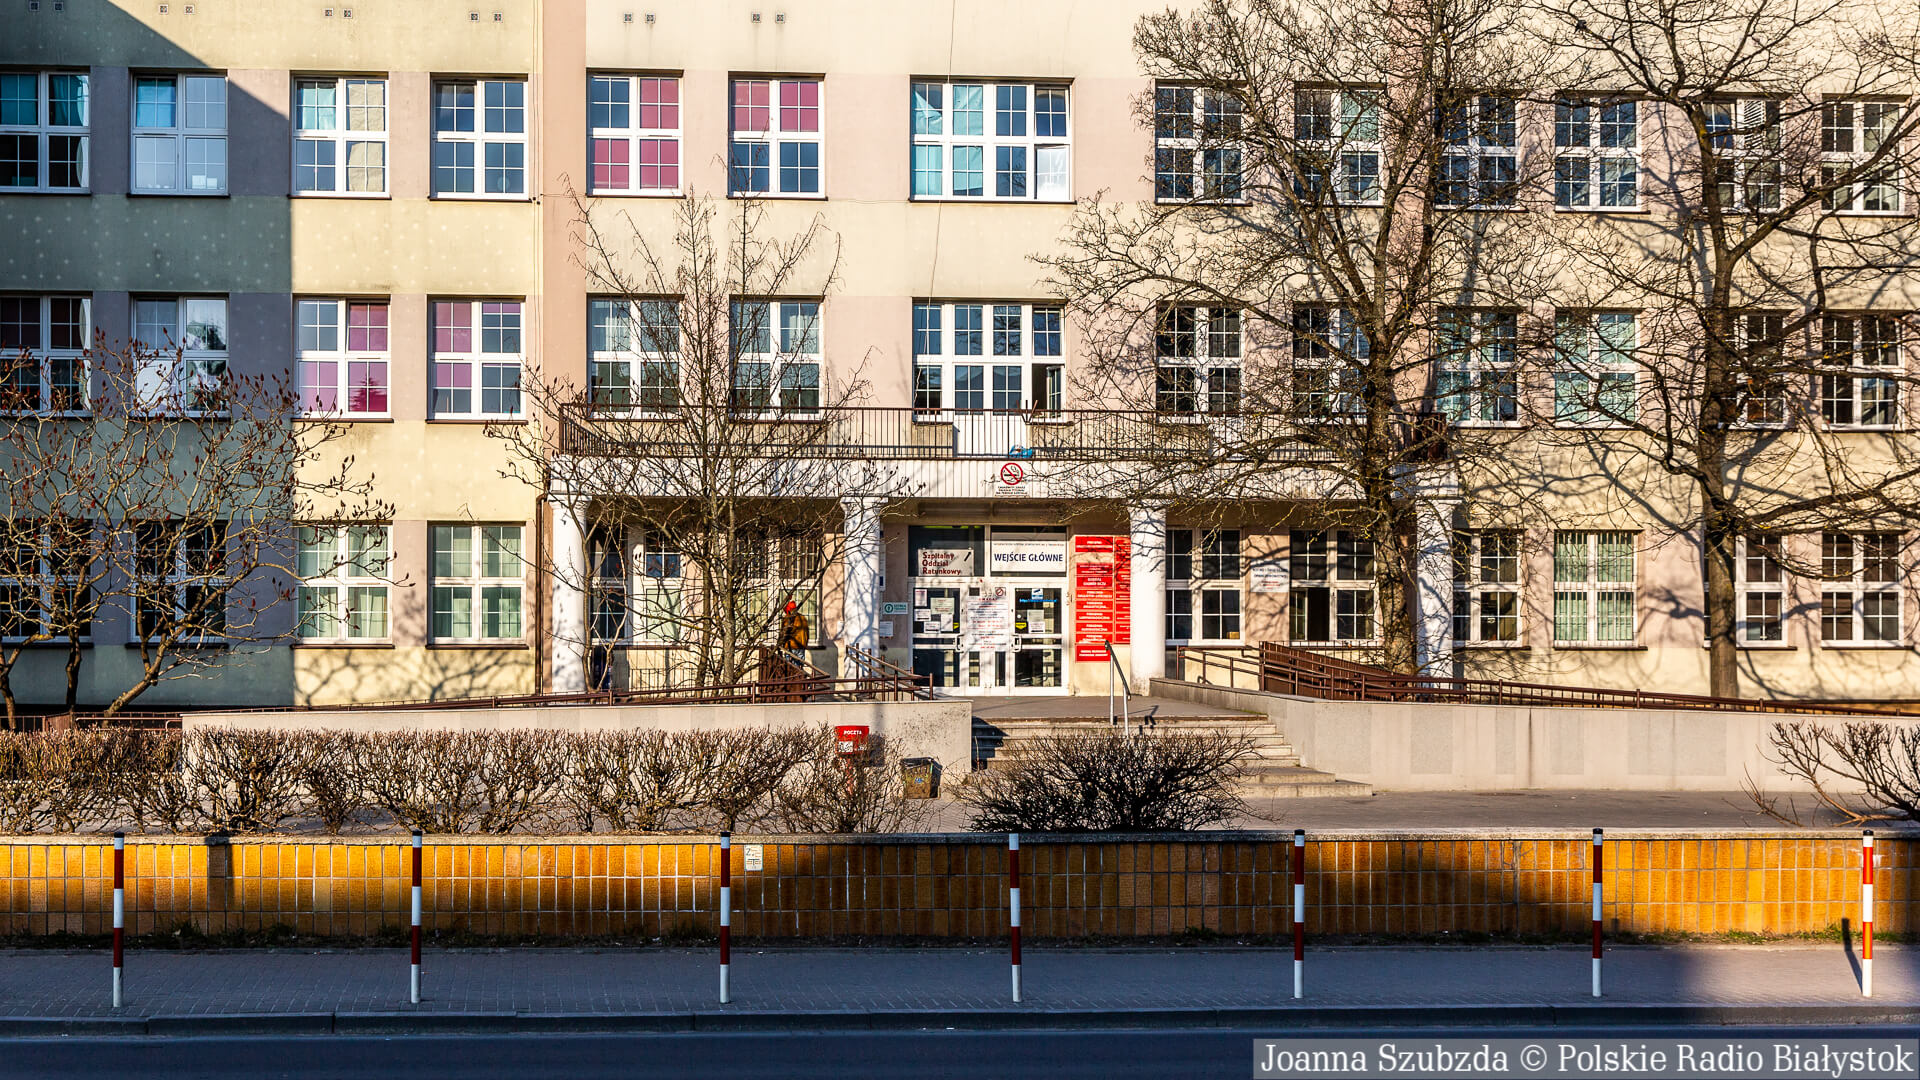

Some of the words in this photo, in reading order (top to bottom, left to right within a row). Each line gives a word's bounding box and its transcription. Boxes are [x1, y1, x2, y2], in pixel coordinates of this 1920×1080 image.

[922, 551, 955, 561] Szpitalny
[994, 552, 1026, 562] WEJŚCIE
[1028, 552, 1063, 562] GŁÓWNE
[922, 559, 949, 567] Oddział
[922, 567, 961, 576] Ratunkowy
